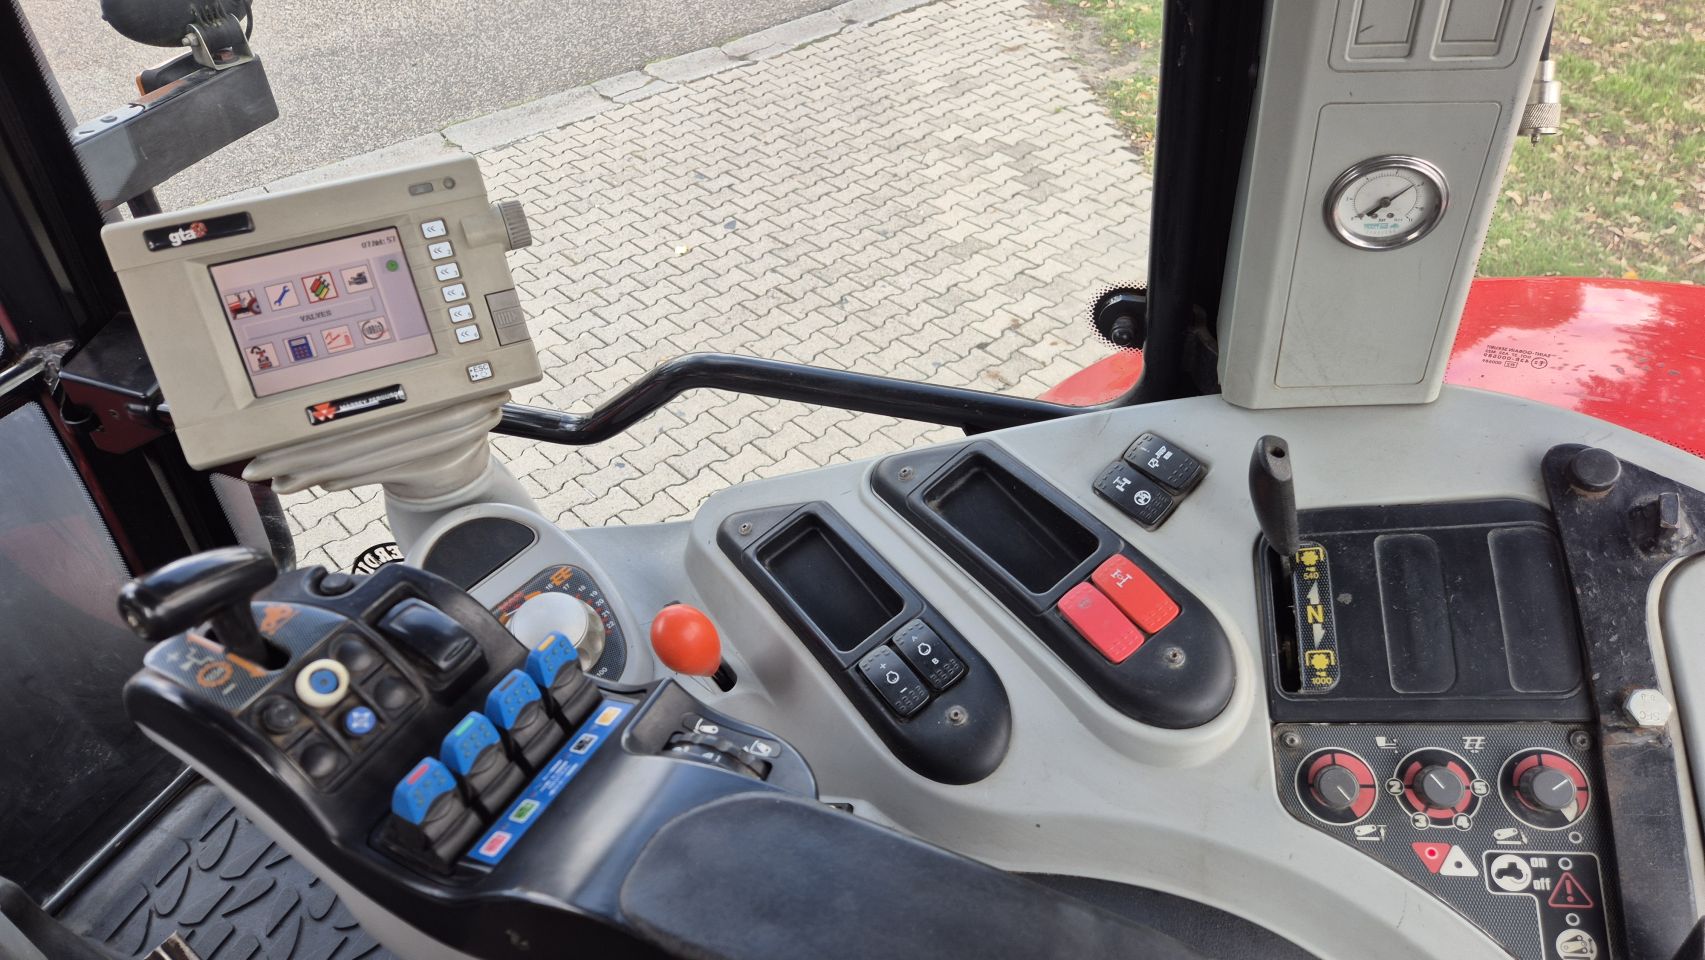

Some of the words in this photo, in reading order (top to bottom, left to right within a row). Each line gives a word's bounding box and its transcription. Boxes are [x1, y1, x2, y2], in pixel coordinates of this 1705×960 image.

[168, 227, 197, 247] gta
[473, 362, 489, 373] ESC
[1303, 572, 1319, 580] 540
[595, 599, 604, 607] 20
[1306, 604, 1324, 624] N
[931, 657, 939, 665] B
[596, 666, 608, 677] 100
[1312, 677, 1333, 685] 1000
[1388, 780, 1401, 793] 2
[1473, 781, 1487, 794] 5
[1414, 814, 1427, 828] 3
[1456, 815, 1470, 829] 4
[1529, 857, 1548, 868] on
[1532, 877, 1551, 890] off
